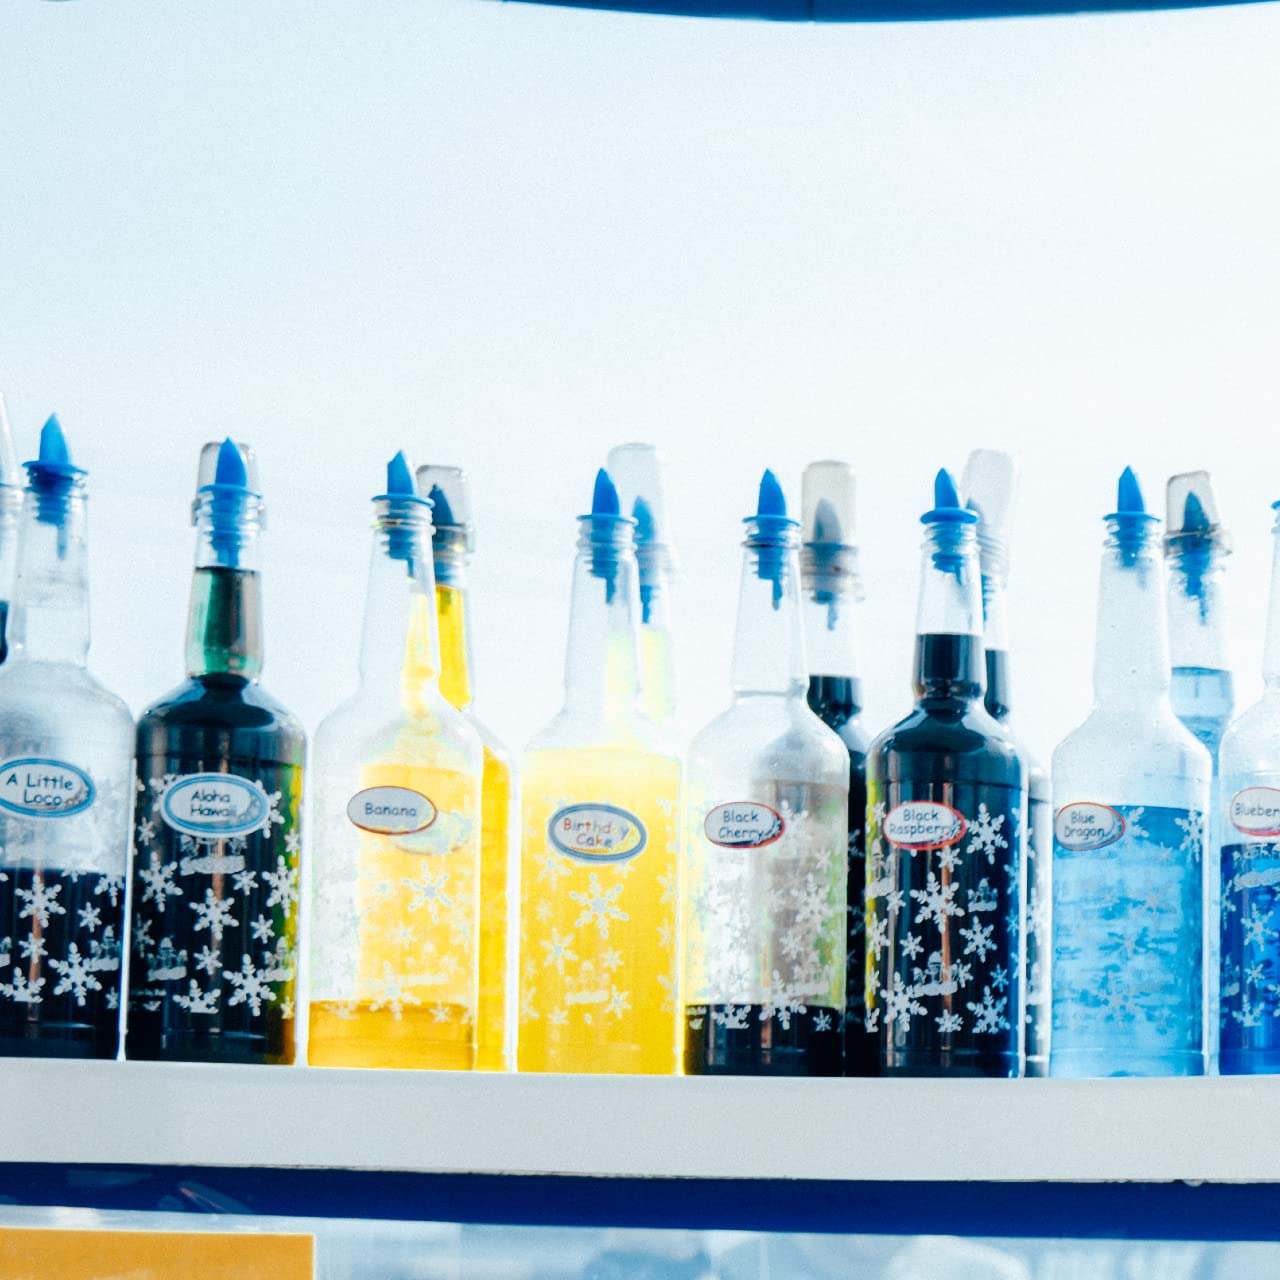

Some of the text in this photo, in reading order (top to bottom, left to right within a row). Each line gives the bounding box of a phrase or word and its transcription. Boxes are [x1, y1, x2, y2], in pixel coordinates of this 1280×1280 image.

[6, 772, 73, 790] A Little
[24, 790, 61, 807] Loco
[191, 791, 231, 803] Aloha
[364, 802, 417, 817] Banana
[723, 810, 758, 822] Black
[903, 809, 939, 822] Black
[1071, 811, 1095, 824] Blue
[563, 818, 630, 840] Birthday
[719, 826, 763, 841] Cherry
[890, 821, 955, 837] Raspberry
[1064, 825, 1104, 841] Dragon
[576, 833, 613, 848] Cake
